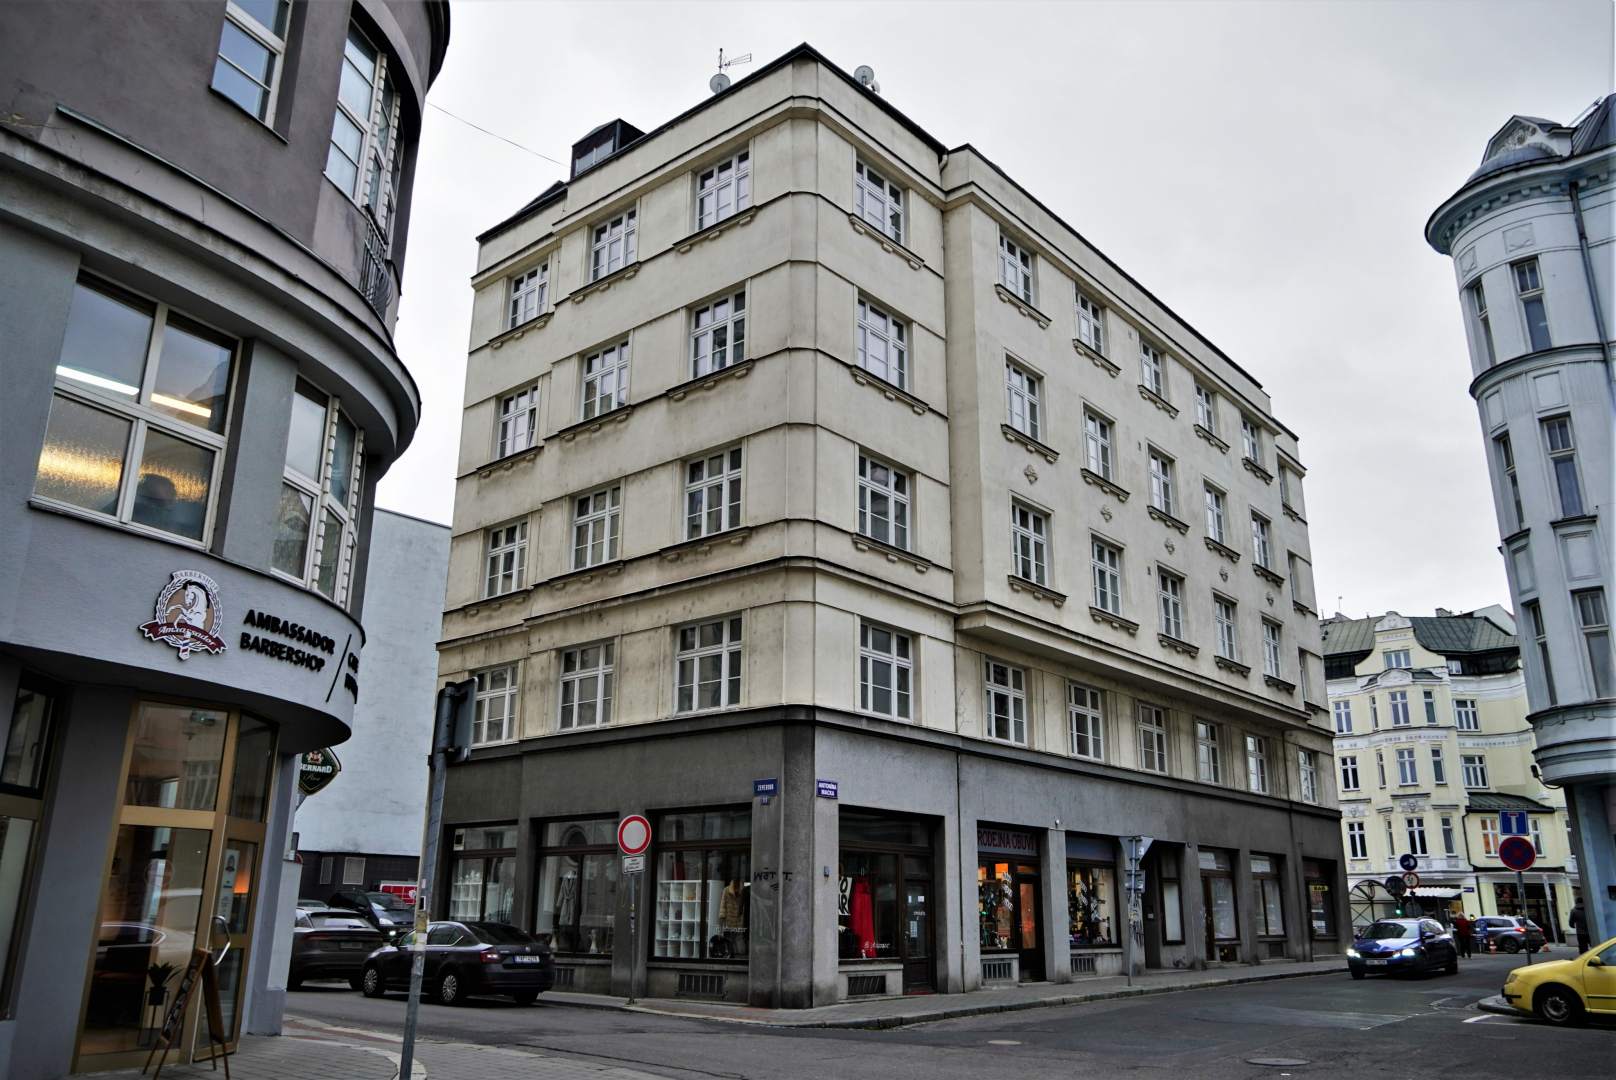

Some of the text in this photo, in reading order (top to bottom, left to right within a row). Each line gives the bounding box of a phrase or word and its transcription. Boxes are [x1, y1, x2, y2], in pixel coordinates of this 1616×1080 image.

[174, 571, 219, 591] BARBERSHOP
[240, 632, 325, 672] BARBERSHOP
[243, 609, 335, 655] AMBASSADOR
